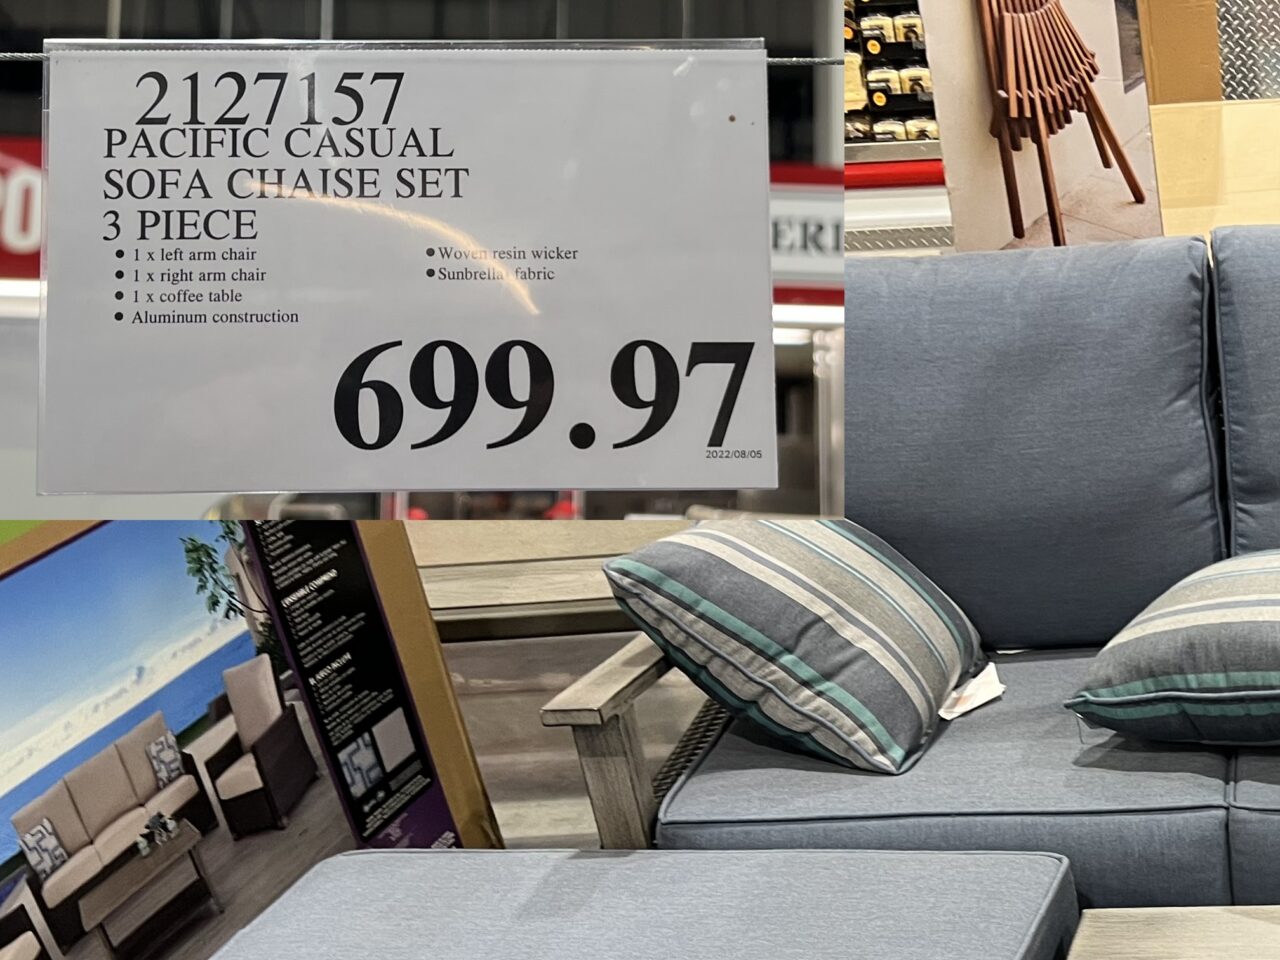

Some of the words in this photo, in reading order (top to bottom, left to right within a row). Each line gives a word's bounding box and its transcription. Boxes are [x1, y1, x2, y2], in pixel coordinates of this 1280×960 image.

[134, 70, 406, 127] 2127157
[103, 127, 271, 160] PACIFIC
[284, 127, 455, 160] CASUAL
[102, 168, 211, 201] SOFA
[227, 168, 382, 200] CHAISE
[395, 168, 470, 200] SET
[102, 210, 122, 242] 3
[137, 210, 259, 241] PIECE
[133, 248, 140, 262] 1
[146, 253, 156, 262] x
[160, 248, 184, 262] left
[188, 252, 217, 262] arm
[221, 248, 257, 261] chair
[438, 246, 488, 260] Woven
[493, 246, 527, 260] resin
[532, 246, 579, 260] wicker
[133, 269, 140, 282] 1
[146, 274, 155, 282] x
[160, 268, 194, 285] right
[198, 273, 226, 282] arm
[231, 268, 267, 282] chair
[438, 267, 504, 281] Sunbrella
[514, 266, 556, 281] fabric
[133, 290, 139, 303] 1
[146, 295, 155, 303] x
[159, 289, 204, 303] coffee
[208, 289, 243, 303] table
[131, 310, 207, 324] Aluminum
[212, 309, 300, 324] construction
[333, 338, 757, 452] 699.97
[705, 449, 763, 459] 2022/08/05
